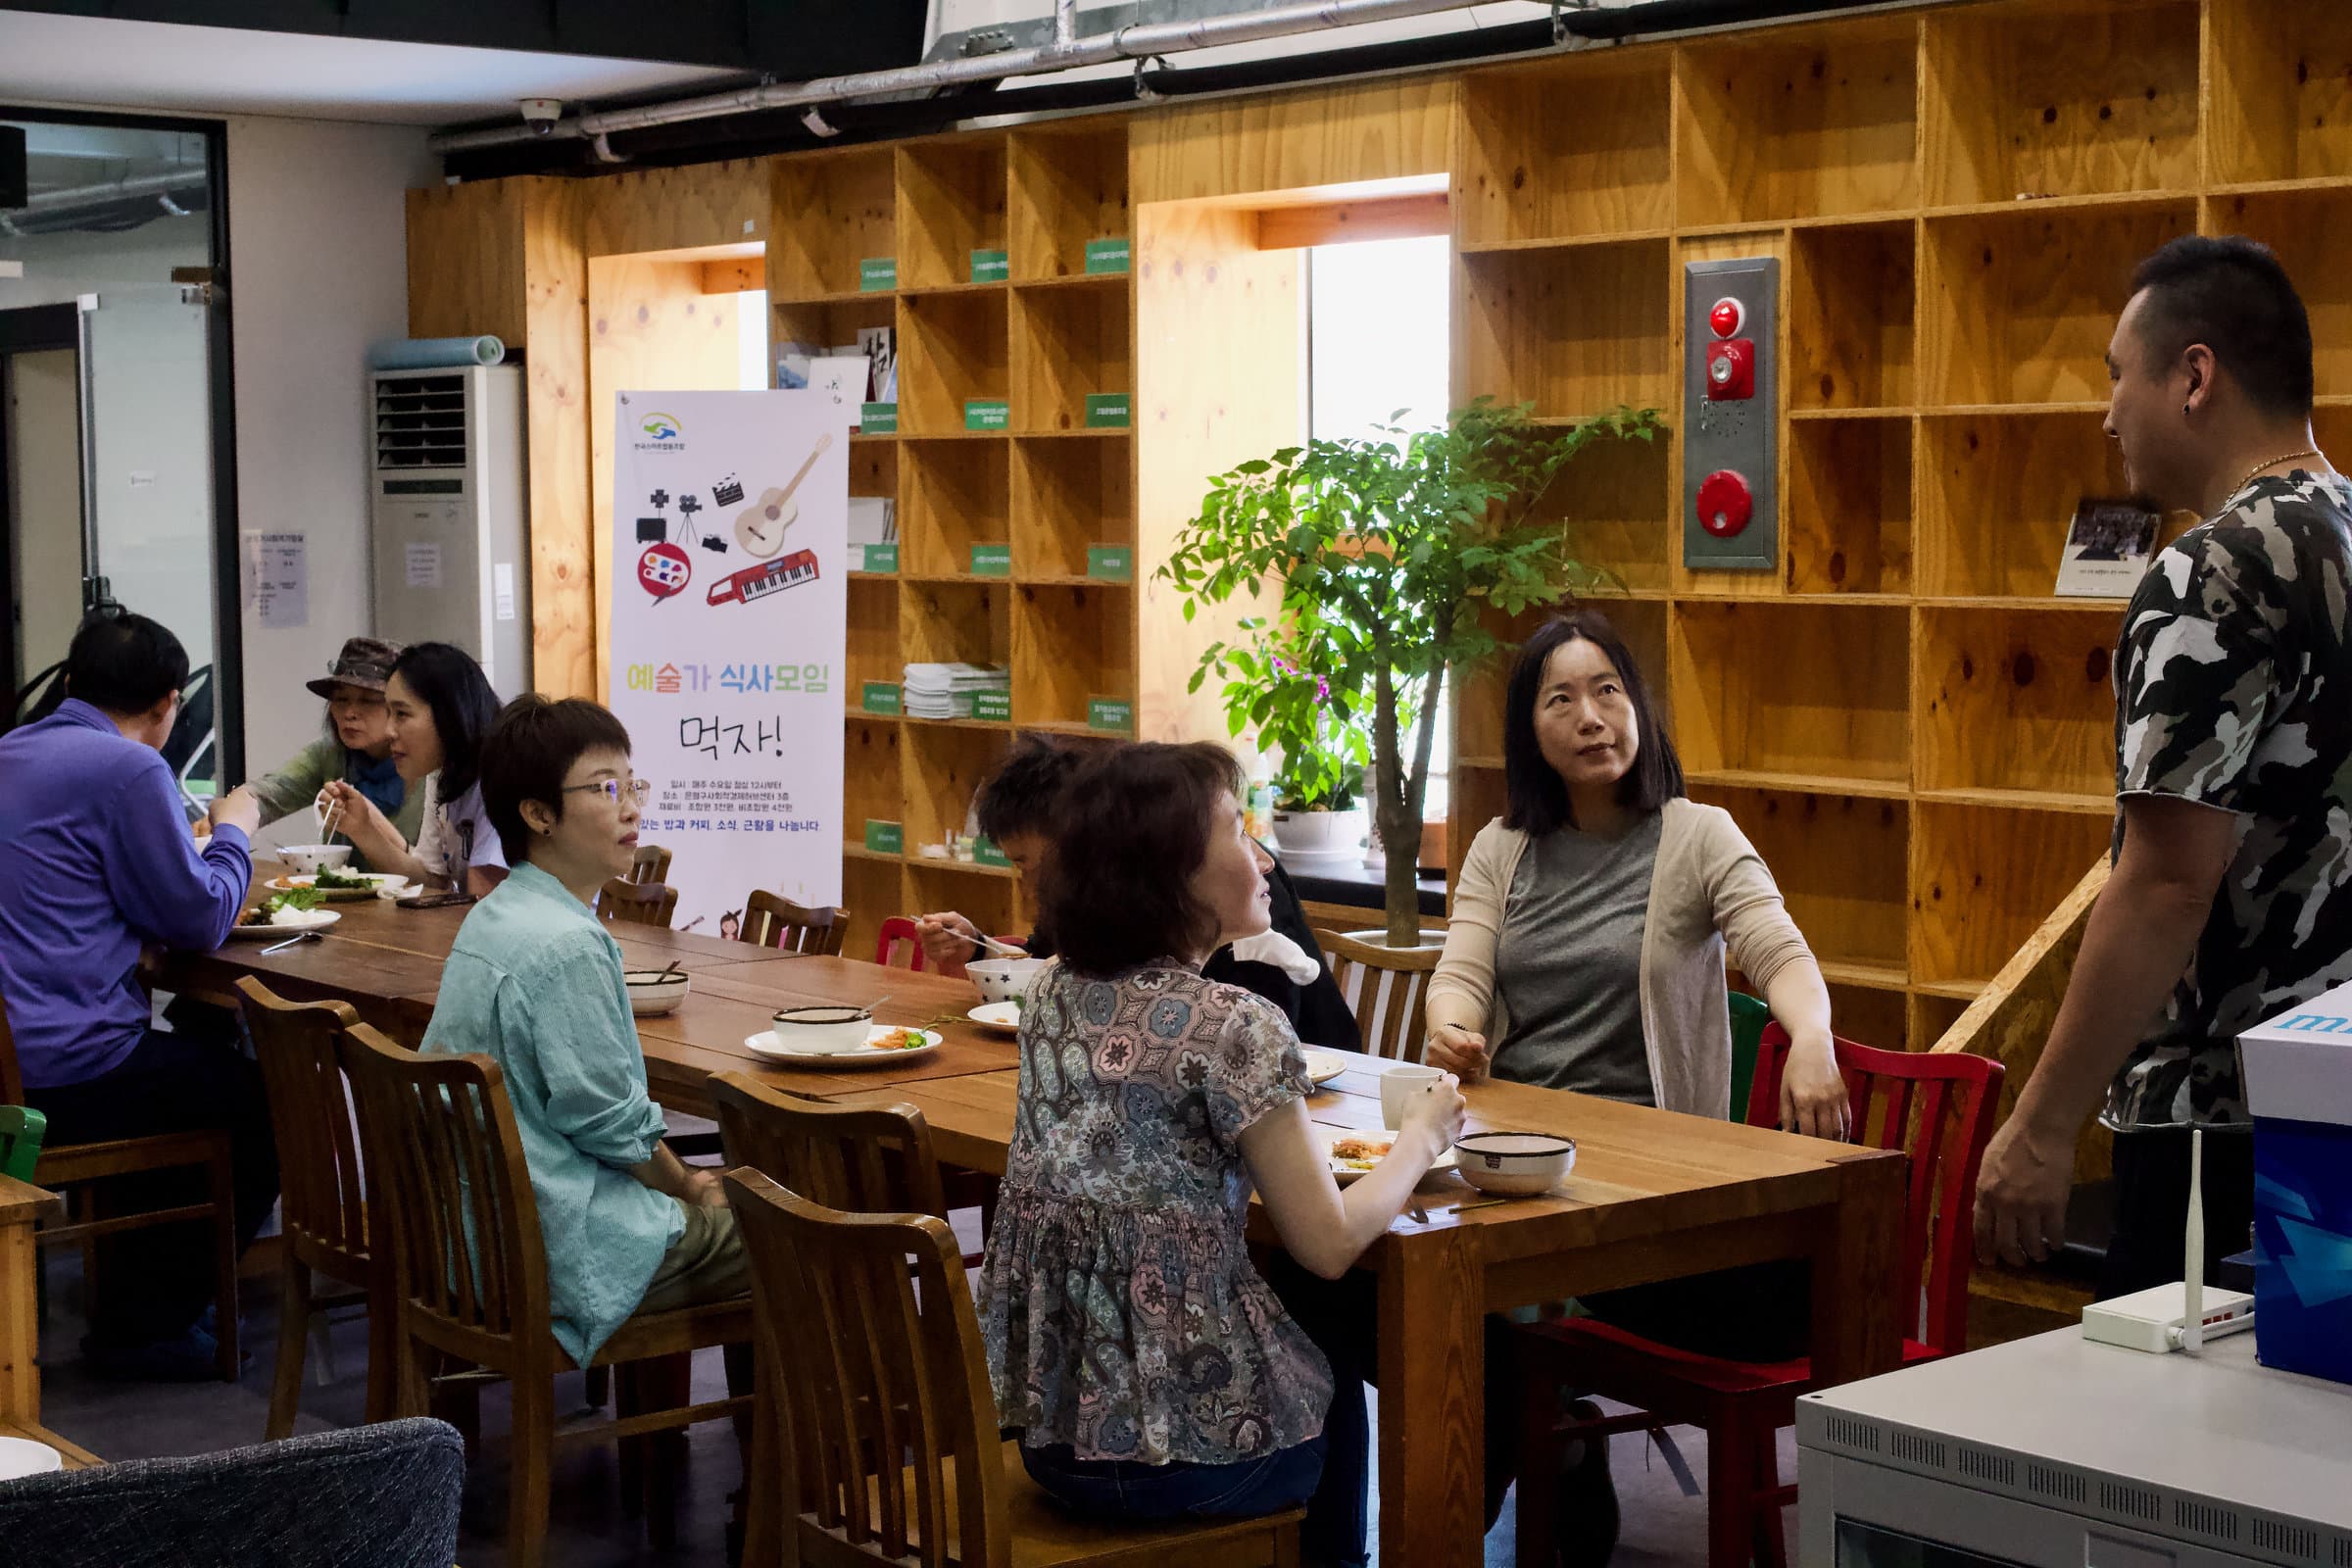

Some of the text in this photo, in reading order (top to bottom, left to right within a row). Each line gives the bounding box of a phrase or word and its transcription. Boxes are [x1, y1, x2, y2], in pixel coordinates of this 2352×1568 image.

[627, 663, 828, 694] 예술가 식사모임
[679, 715, 784, 761] 먹자!
[670, 780, 686, 790] 일시
[710, 780, 733, 790] 수요일
[641, 819, 660, 831] 있는
[663, 819, 686, 831] 밥과
[2274, 1014, 2352, 1034] m
